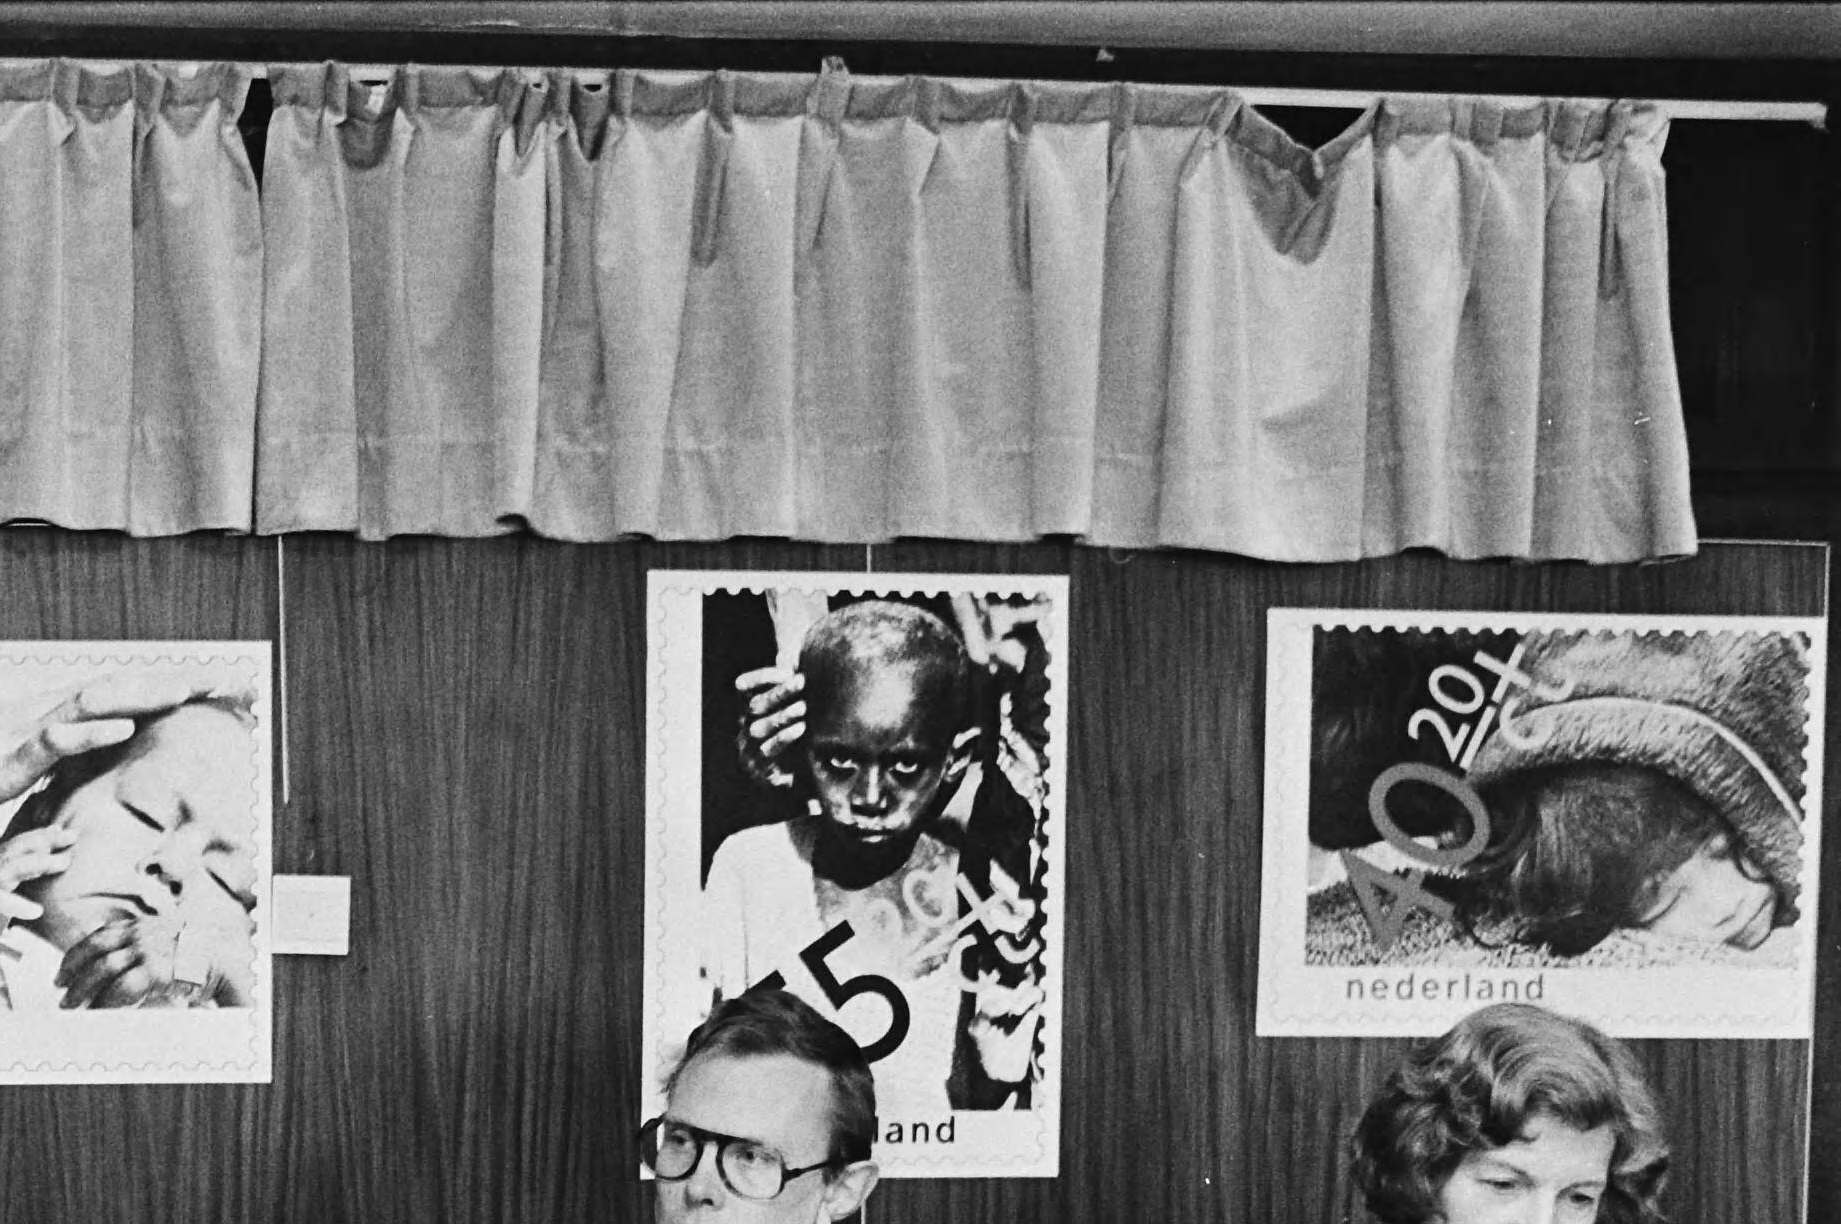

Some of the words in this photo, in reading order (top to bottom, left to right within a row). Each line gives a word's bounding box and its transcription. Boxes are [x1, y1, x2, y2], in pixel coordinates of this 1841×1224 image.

[1340, 762, 1491, 943] 40
[744, 918, 910, 1065] 5
[1346, 974, 1545, 1000] nederland
[873, 1115, 956, 1144] land
